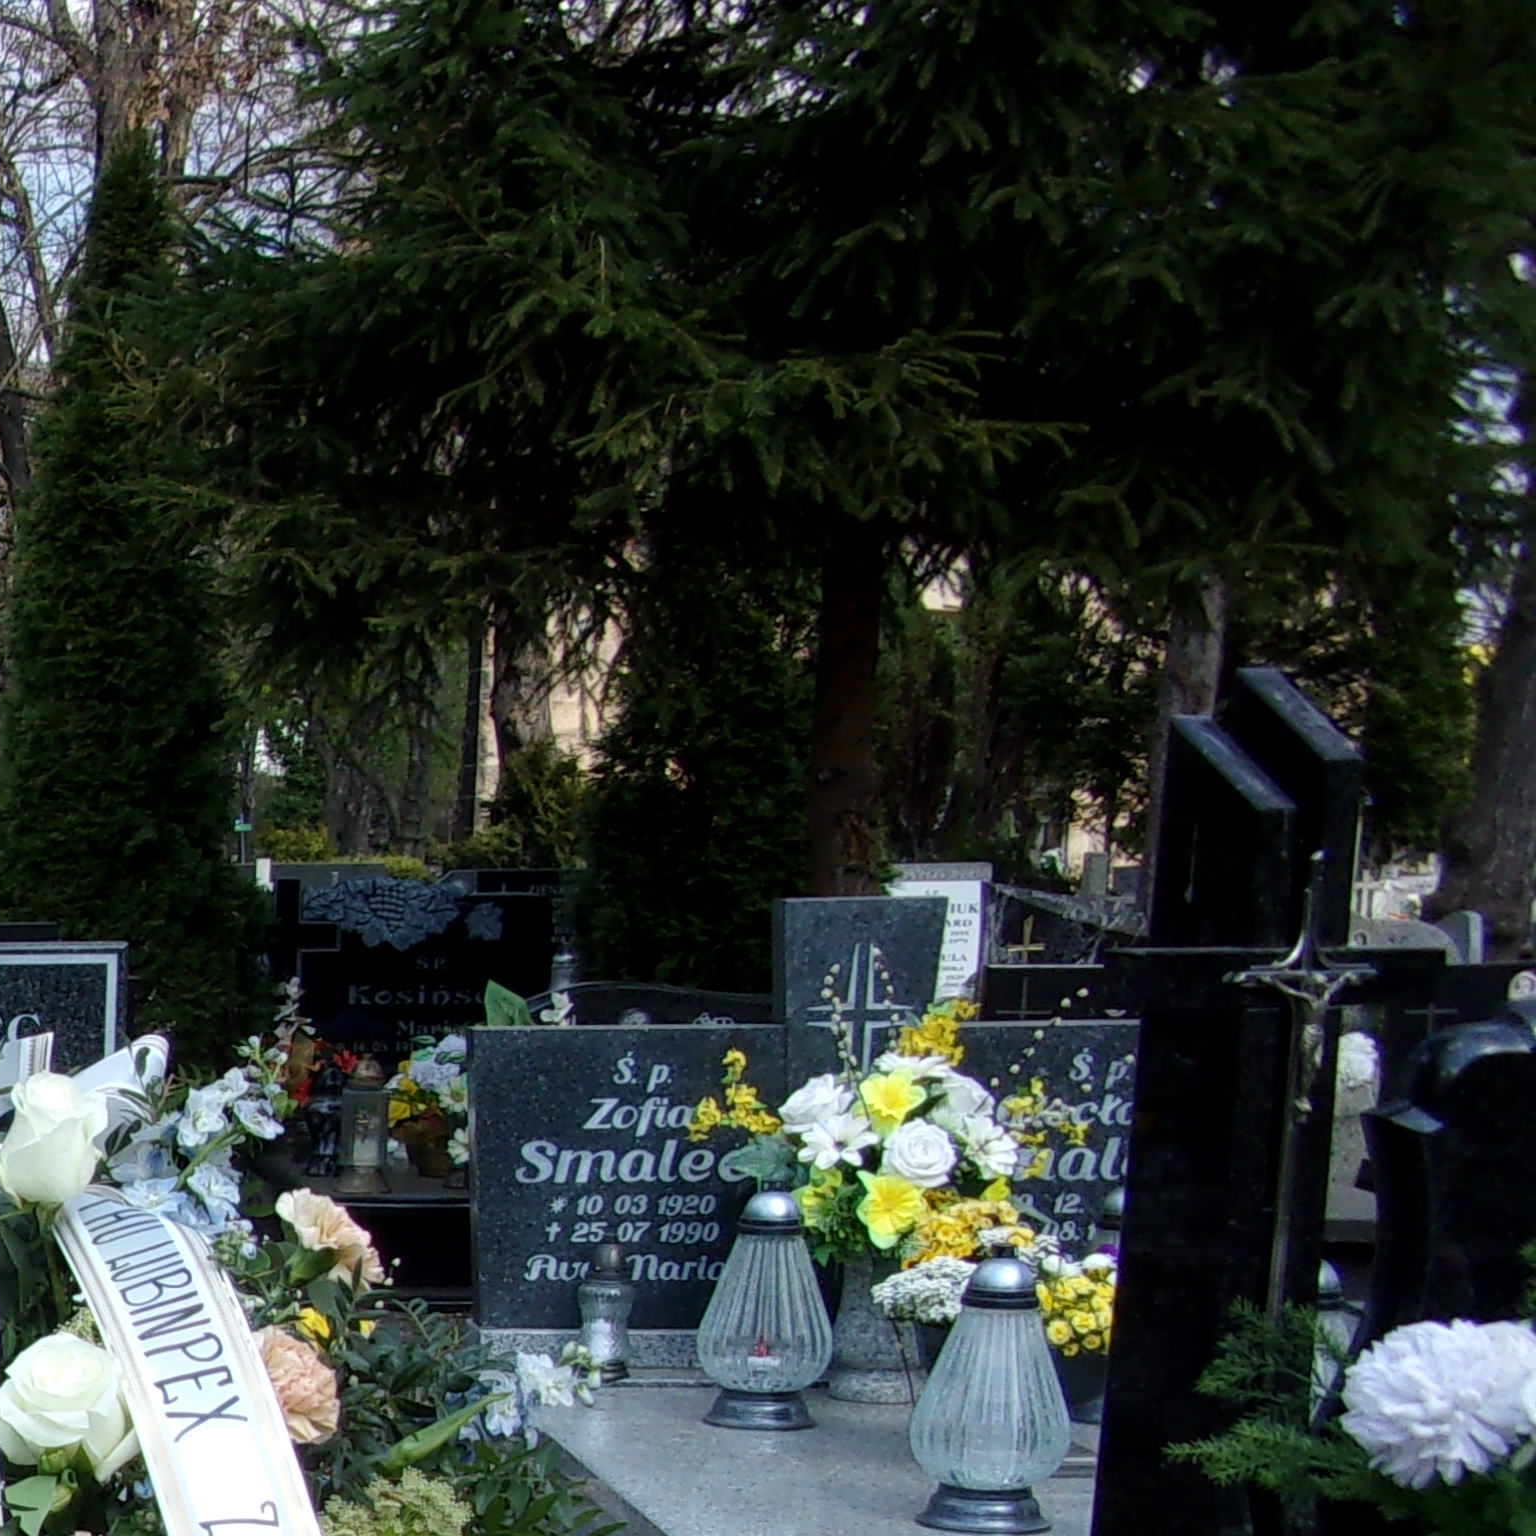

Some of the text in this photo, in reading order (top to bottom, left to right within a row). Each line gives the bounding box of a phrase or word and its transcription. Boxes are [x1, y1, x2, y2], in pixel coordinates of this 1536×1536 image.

[348, 984, 484, 1005] Kosińsc
[582, 1098, 693, 1137] Zofia
[515, 1140, 750, 1185] Smalec
[576, 1195, 716, 1215] 10 03 1920
[571, 1221, 720, 1243] 25 07 1990
[105, 1239, 248, 1443] LUBINPEX
